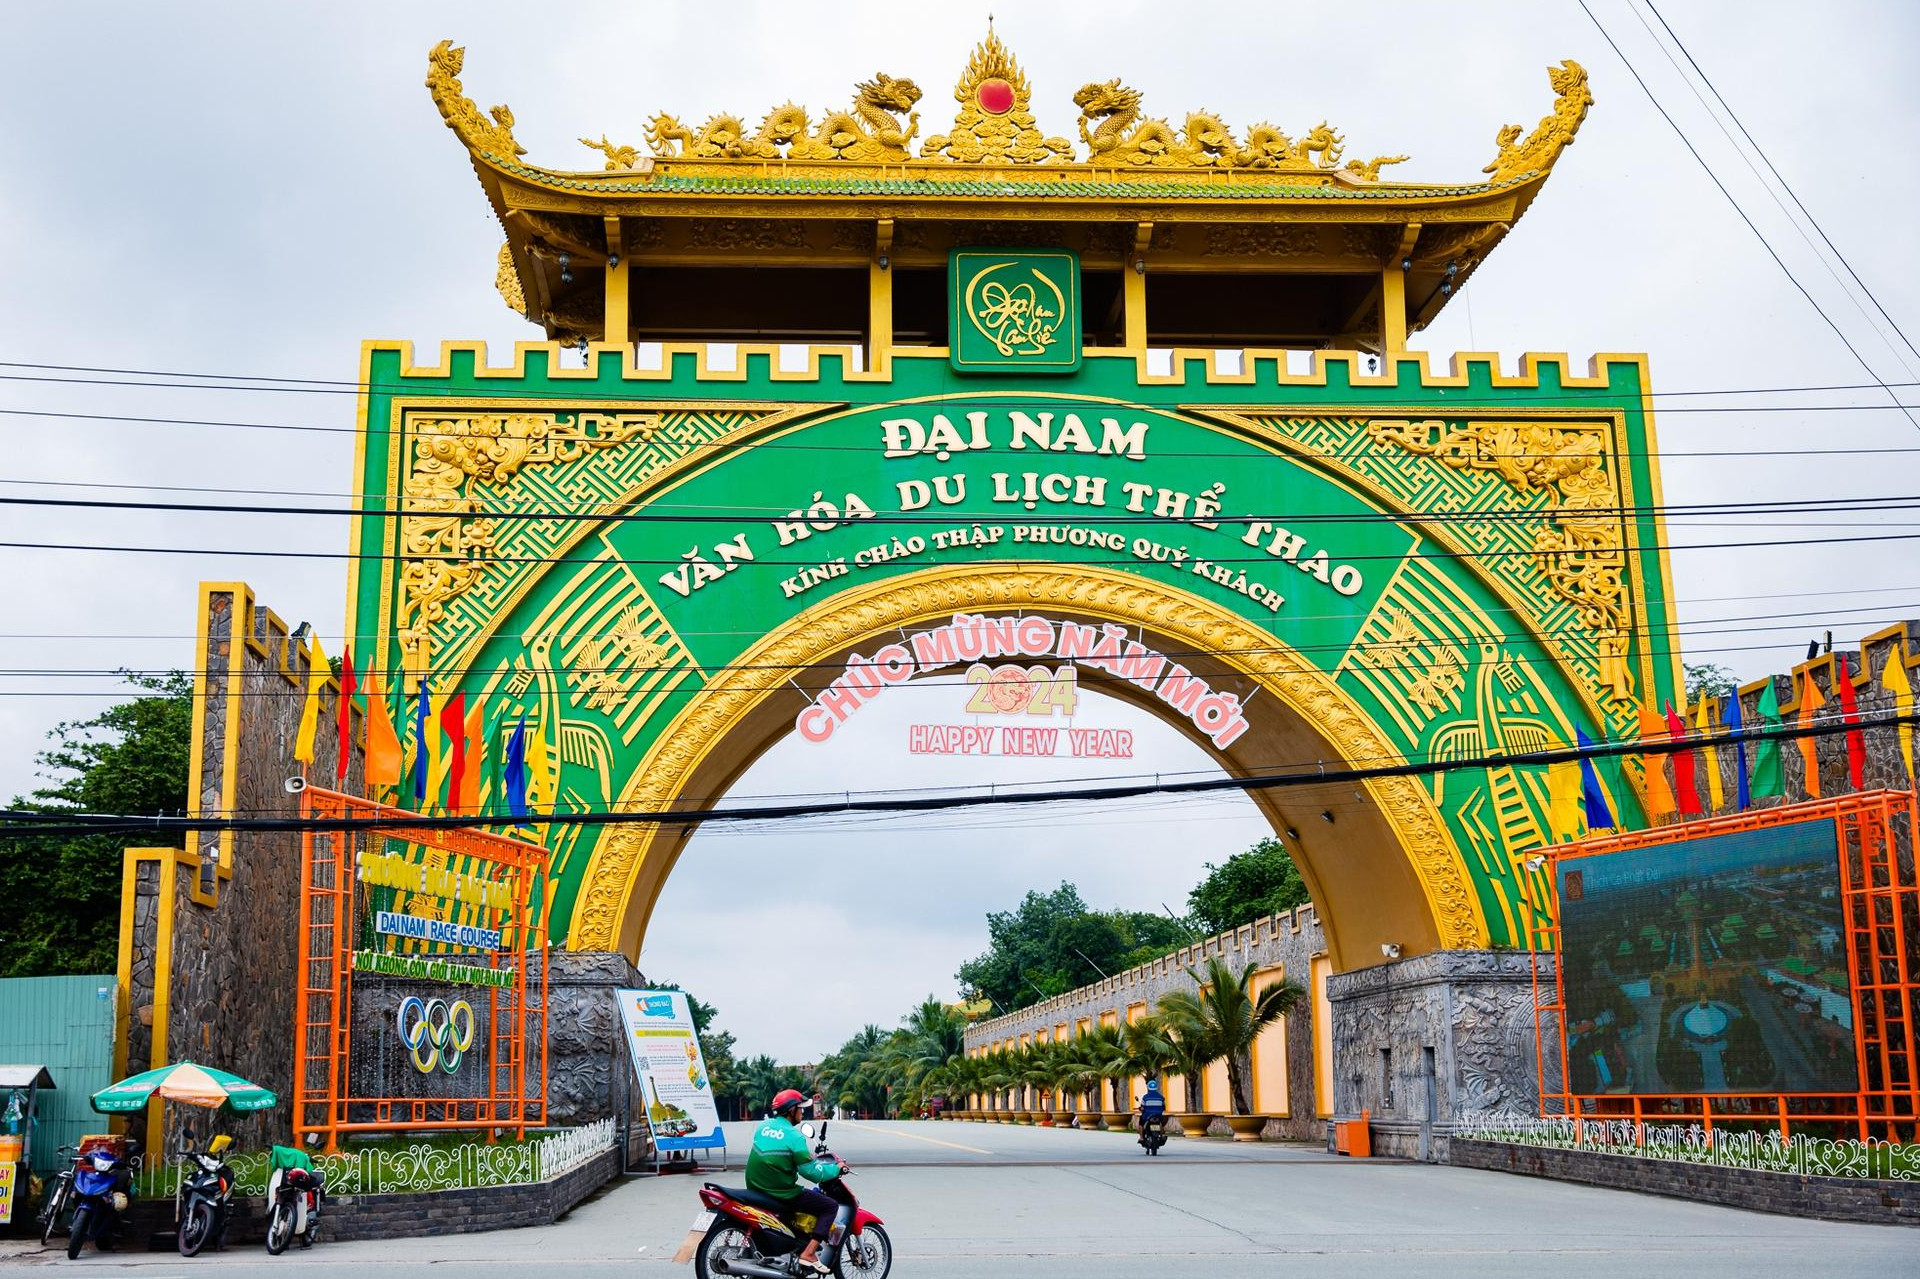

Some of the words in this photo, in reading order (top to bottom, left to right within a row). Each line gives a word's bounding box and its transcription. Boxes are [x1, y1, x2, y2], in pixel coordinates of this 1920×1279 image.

[881, 412, 991, 461] ĐẠI
[1008, 412, 1149, 461] NAM
[659, 533, 754, 597] VĂN
[771, 491, 876, 546] HÓA
[896, 474, 966, 511] DU
[991, 472, 1107, 510] LỊCH
[1123, 482, 1226, 531] THỂ
[1240, 515, 1363, 596] THAO
[780, 558, 849, 598] KÍNH
[854, 536, 926, 568] CHÀO
[931, 523, 1004, 549] THẬP
[1012, 525, 1125, 551] PHƯƠNG
[1132, 538, 1189, 568] QUÝ
[1192, 558, 1286, 613] KHÁCH
[799, 647, 912, 743] CHÚC
[915, 614, 1053, 673] MỪNG
[1060, 626, 1166, 690] NĂM
[1161, 667, 1249, 748] MỚI
[909, 725, 995, 755] HAPPY
[1002, 727, 1058, 756] NEW
[1071, 729, 1133, 757] YEAR
[430, 923, 457, 942] RACE
[460, 926, 499, 950] COURSE
[375, 951, 408, 976] KHÔNG
[761, 1126, 785, 1140] Grab
